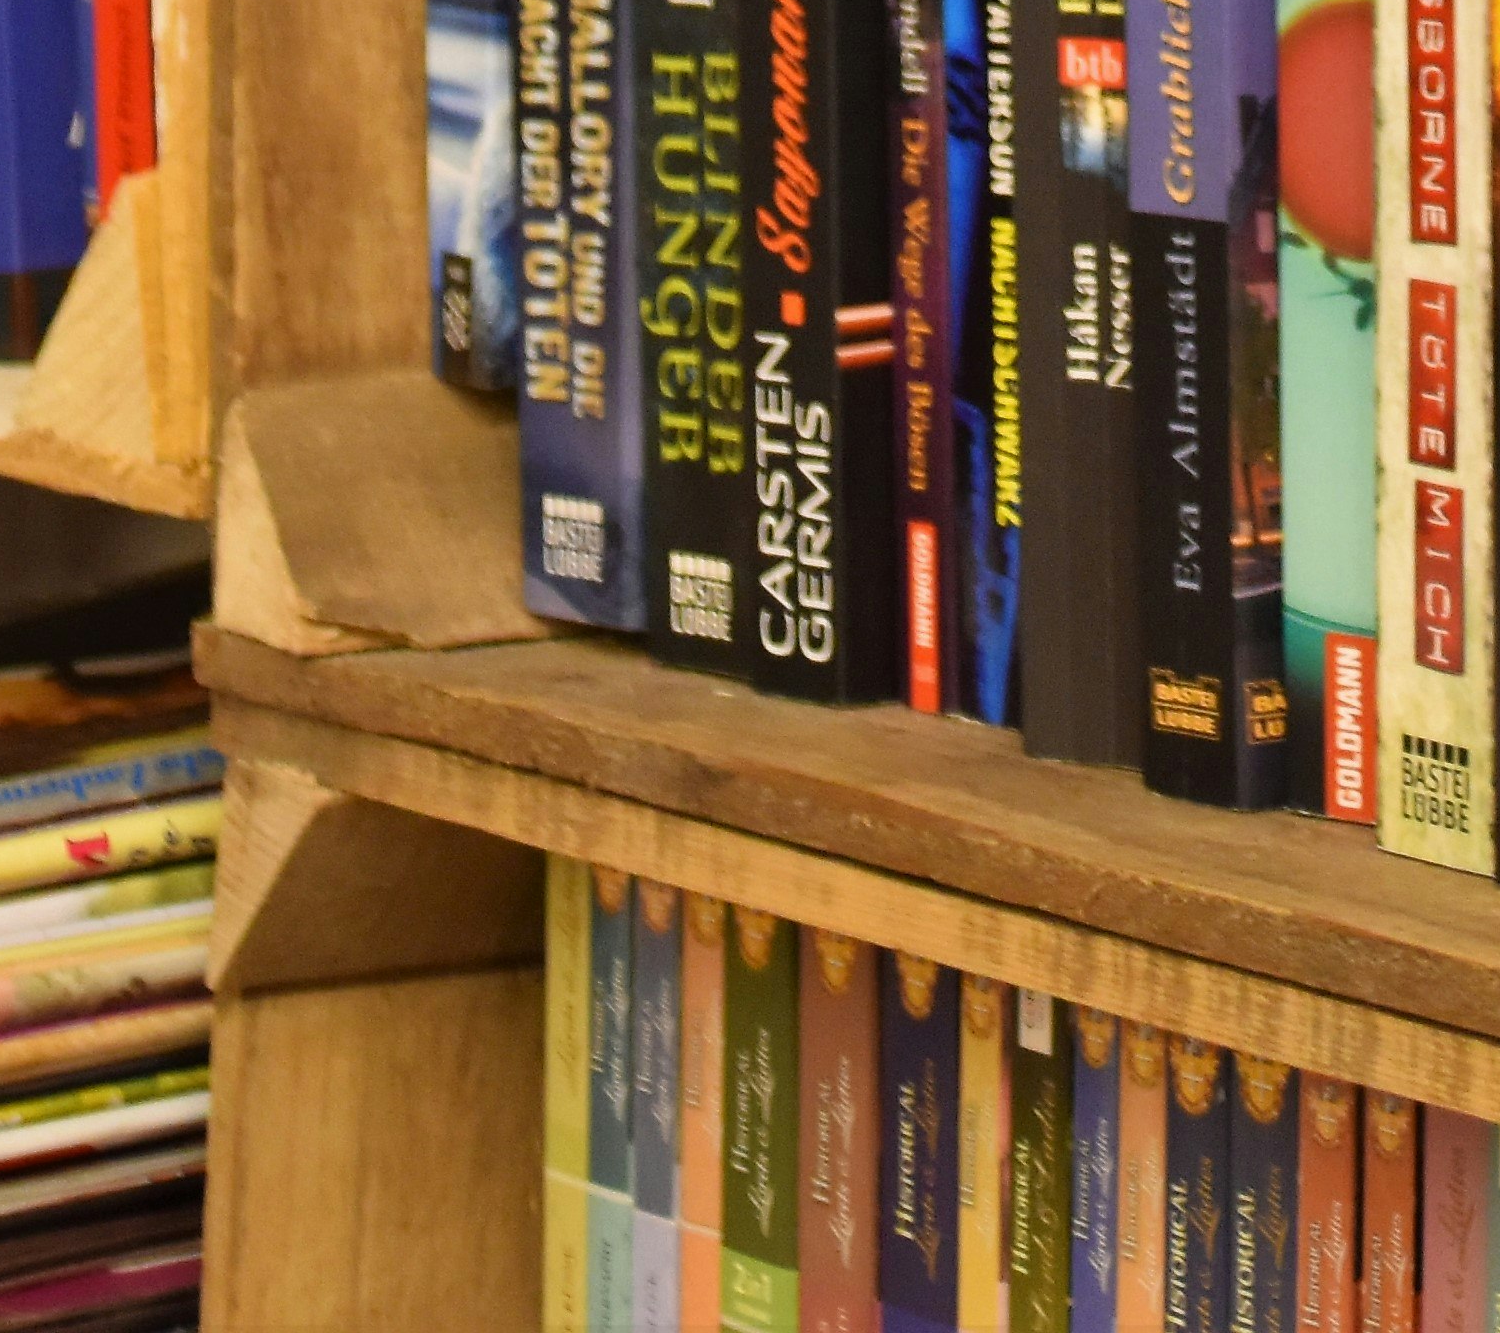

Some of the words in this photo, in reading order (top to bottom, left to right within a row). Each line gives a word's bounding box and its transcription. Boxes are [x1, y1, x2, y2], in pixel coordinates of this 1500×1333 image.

[1064, 45, 1125, 83] btb
[522, 115, 561, 206] DER
[522, 214, 571, 404] TOTEN
[1066, 243, 1102, 384] Håkan
[1105, 245, 1135, 390] Nesser
[1167, 229, 1201, 476] Almstädt
[755, 333, 794, 658] CARSTEN
[796, 401, 836, 663] GERMIS
[1173, 511, 1203, 594] Eva
[1334, 645, 1365, 811] GOLDMANN
[1402, 755, 1472, 803] BASTEI
